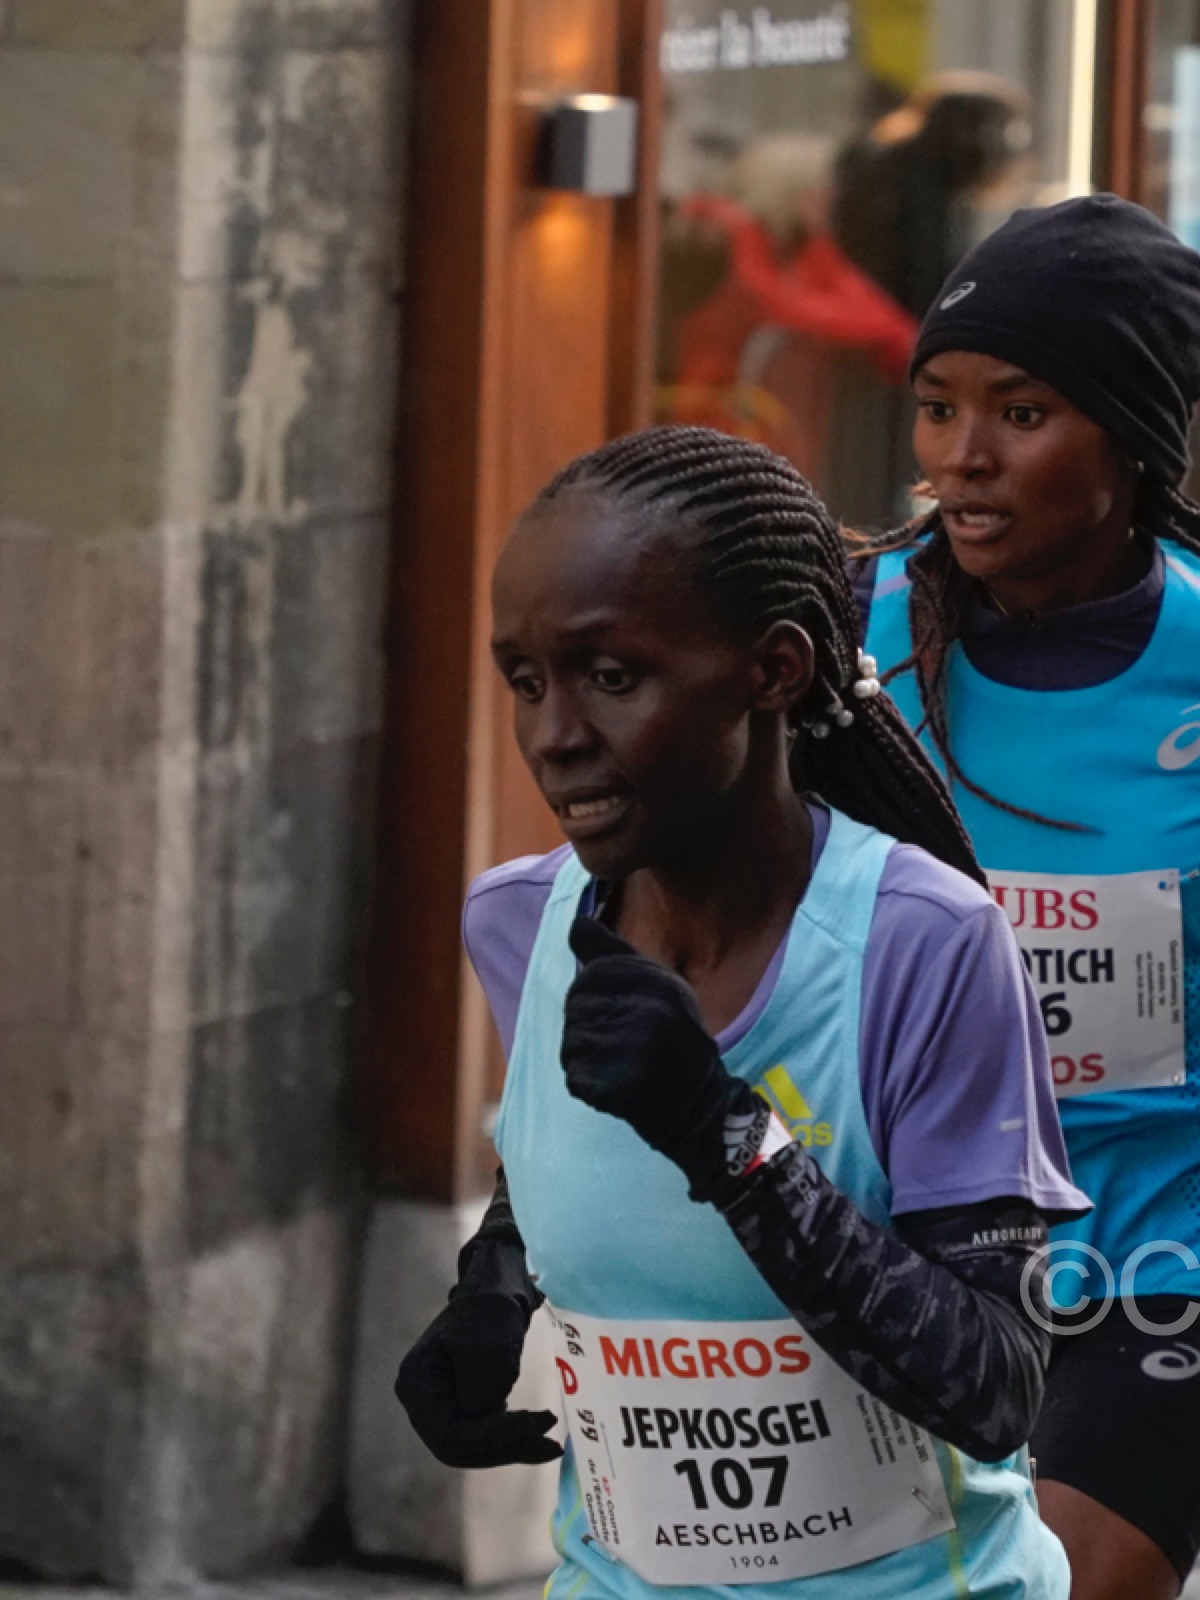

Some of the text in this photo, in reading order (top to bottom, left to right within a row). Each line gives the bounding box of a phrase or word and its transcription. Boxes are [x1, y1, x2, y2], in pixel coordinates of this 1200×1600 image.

[992, 885, 1099, 931] UBS
[600, 1335, 812, 1379] MIGROS
[620, 1400, 831, 1450] JEPKOSGEI
[674, 1455, 789, 1510] 107
[655, 1507, 853, 1547] AESCHBACH
[730, 1556, 779, 1569] 1904
